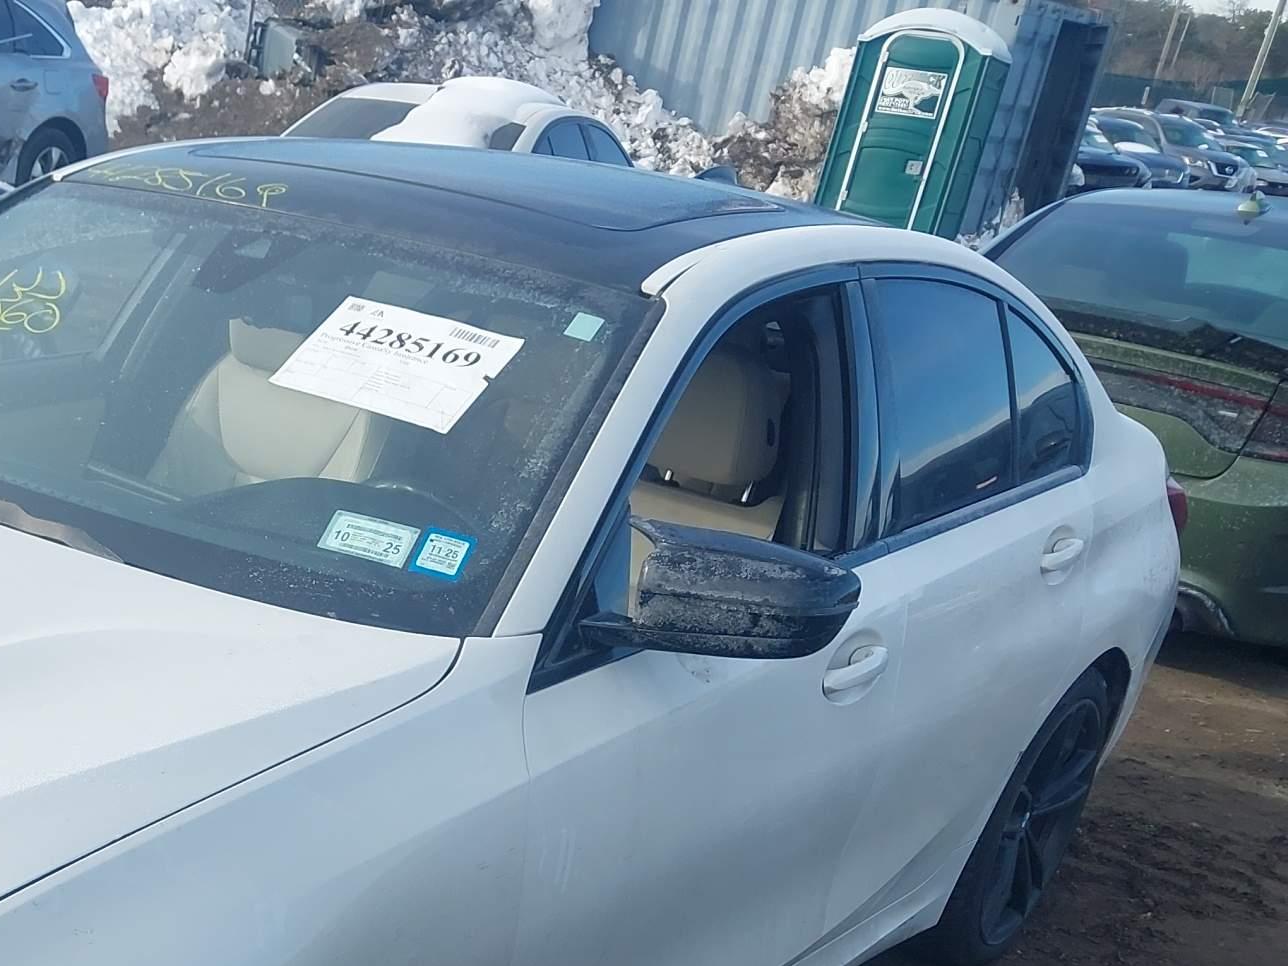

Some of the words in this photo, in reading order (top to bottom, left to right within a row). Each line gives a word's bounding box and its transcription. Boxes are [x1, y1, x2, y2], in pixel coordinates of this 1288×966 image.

[339, 320, 482, 368] 44285169
[334, 529, 351, 542] 10
[383, 541, 403, 555] 25
